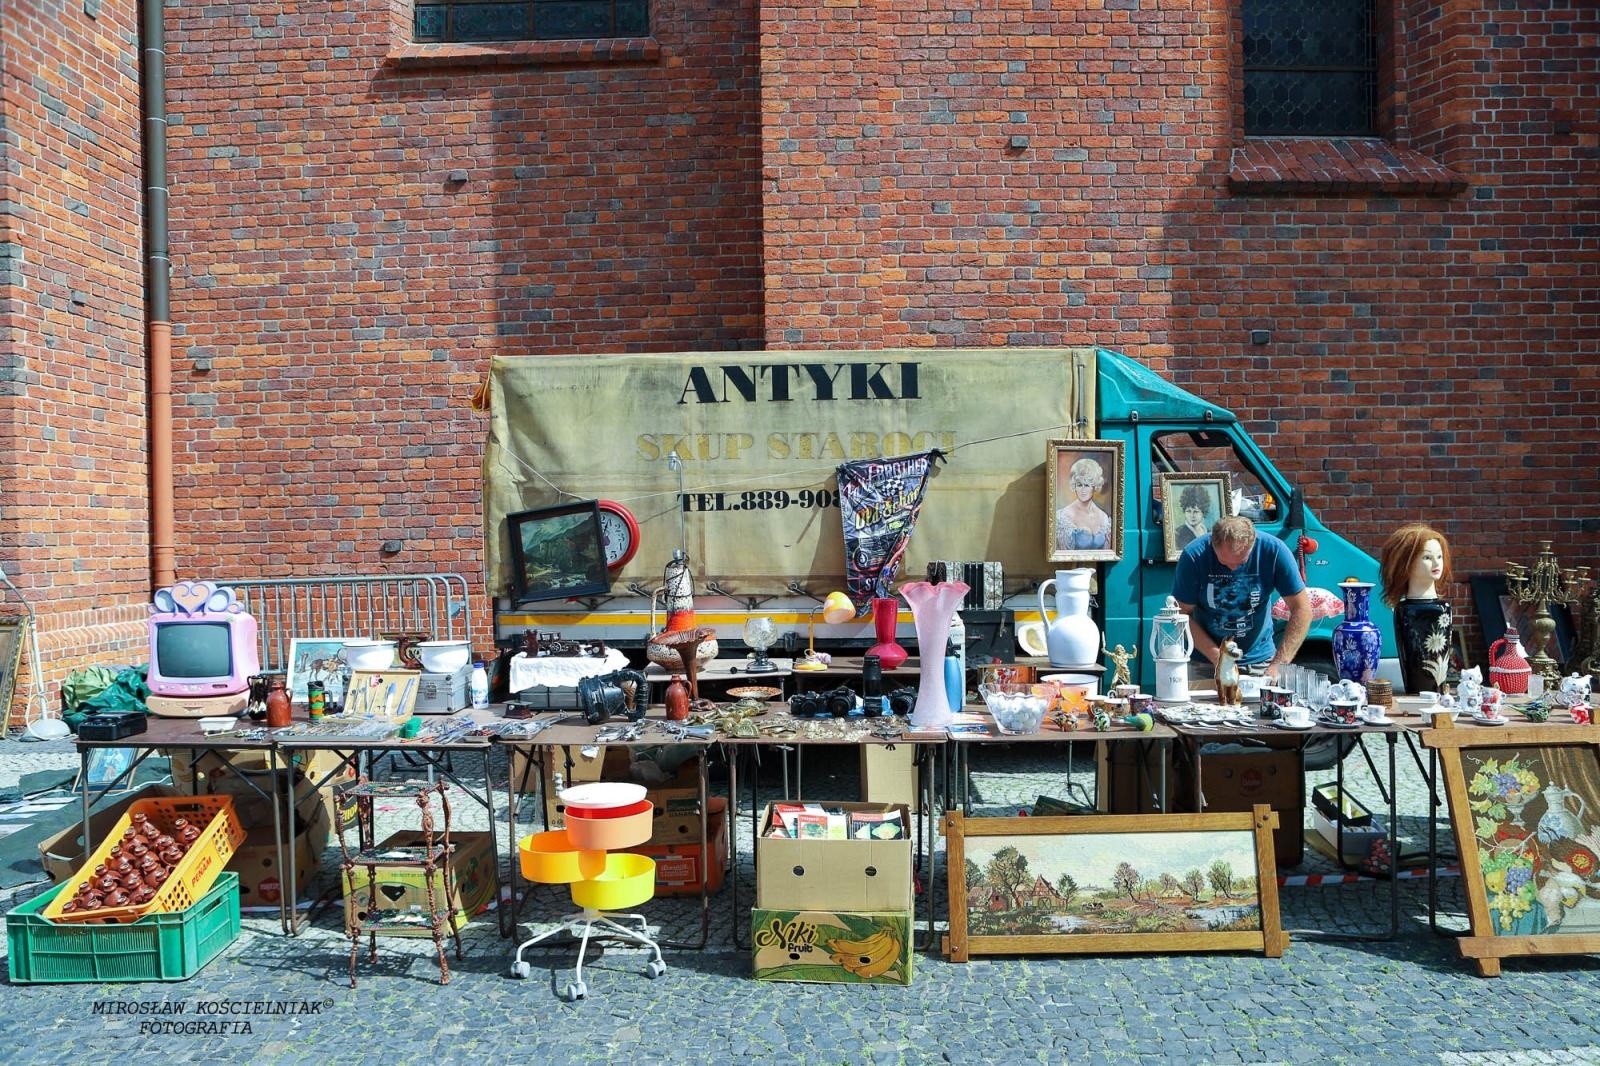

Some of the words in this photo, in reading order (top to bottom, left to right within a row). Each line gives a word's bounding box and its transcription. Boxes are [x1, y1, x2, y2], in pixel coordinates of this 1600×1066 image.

[677, 362, 922, 404] ANTYKI
[636, 432, 754, 461] SKUP
[756, 919, 818, 949] Niki
[787, 942, 814, 954] fruit
